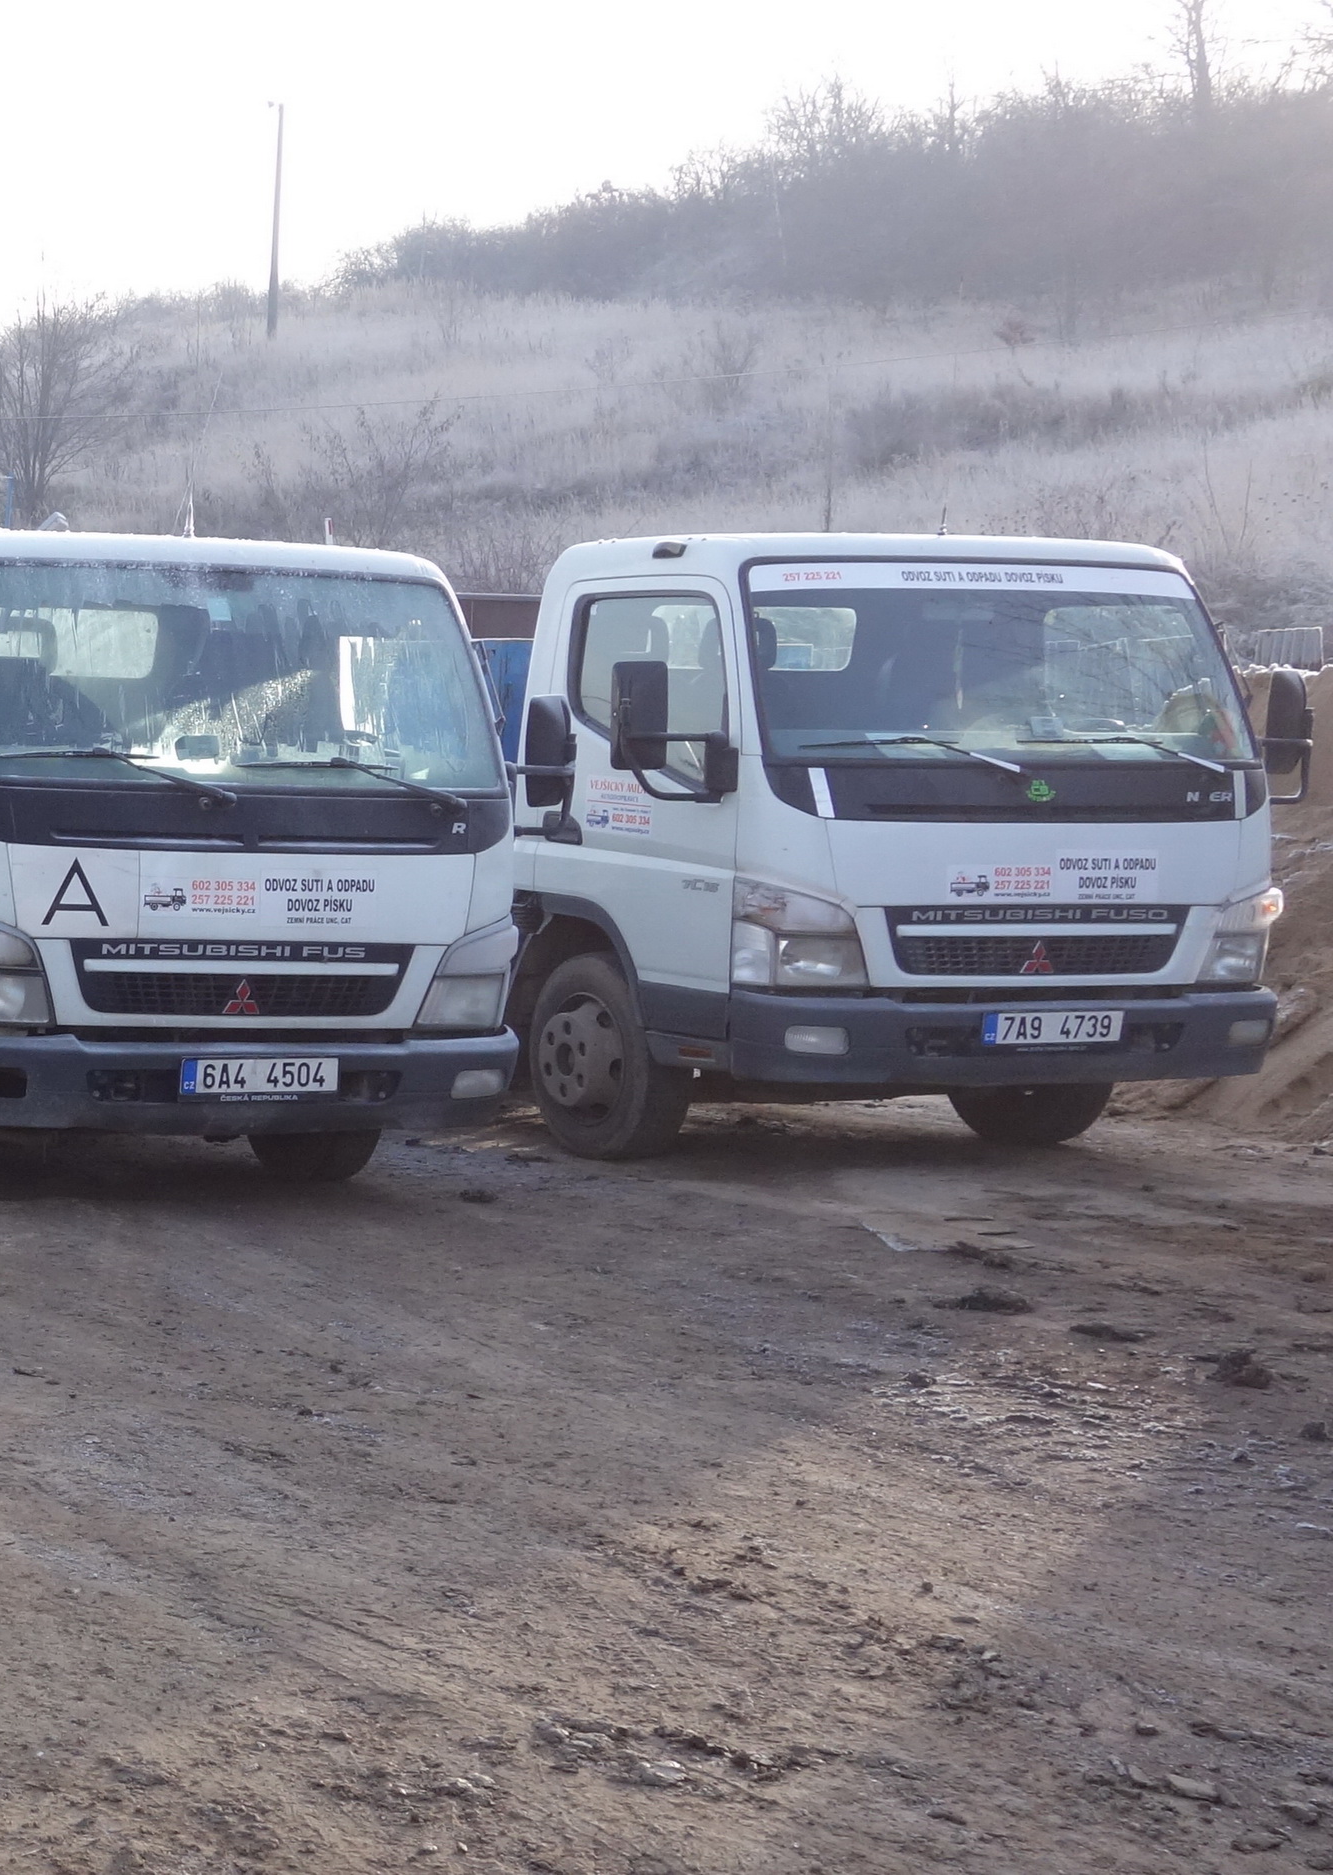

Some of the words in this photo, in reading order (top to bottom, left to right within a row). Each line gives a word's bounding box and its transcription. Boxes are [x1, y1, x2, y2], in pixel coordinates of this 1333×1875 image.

[901, 571, 932, 582] ODVOZ
[935, 571, 956, 582] SUTI
[958, 571, 964, 582] A
[966, 571, 1002, 583] ODPADU
[1005, 572, 1034, 583] DOVOZ
[1036, 570, 1064, 584] PÍSKU
[452, 822, 467, 834] R
[1059, 858, 1089, 871] ODVOZ
[1091, 858, 1111, 871] SUTI
[1113, 858, 1120, 870] A
[1123, 858, 1157, 871] ODPADU
[994, 867, 1012, 877] 602
[1015, 867, 1032, 877] 305
[1034, 866, 1051, 876] 334
[192, 880, 211, 890] 602
[214, 881, 234, 891] 305
[237, 881, 256, 892] 334
[264, 878, 297, 893] ODVOZ
[300, 878, 324, 893] SUTI
[327, 879, 334, 892] A
[336, 878, 375, 893] ODPADU
[994, 880, 1012, 890] 257
[1014, 880, 1031, 890] 225
[1034, 880, 1050, 890] 221
[1078, 876, 1108, 889] DOVOZ
[1110, 873, 1137, 889] PÍSKU
[41, 857, 110, 927] A
[192, 894, 210, 905] 257
[214, 895, 233, 905] 225
[236, 895, 255, 906] 221
[287, 898, 320, 912] DOVOZ
[323, 895, 353, 912] PÍSKU
[911, 909, 1082, 922] MITSUBISHI
[1091, 909, 1168, 920] FUSO
[102, 943, 291, 957] MITSUBISHI
[302, 946, 366, 958] FUS
[1002, 1016, 1042, 1040] 7A9
[1060, 1015, 1112, 1039] 4739
[202, 1063, 246, 1089] 6A4
[266, 1062, 325, 1088] 4504
[183, 1081, 195, 1090] CZ
